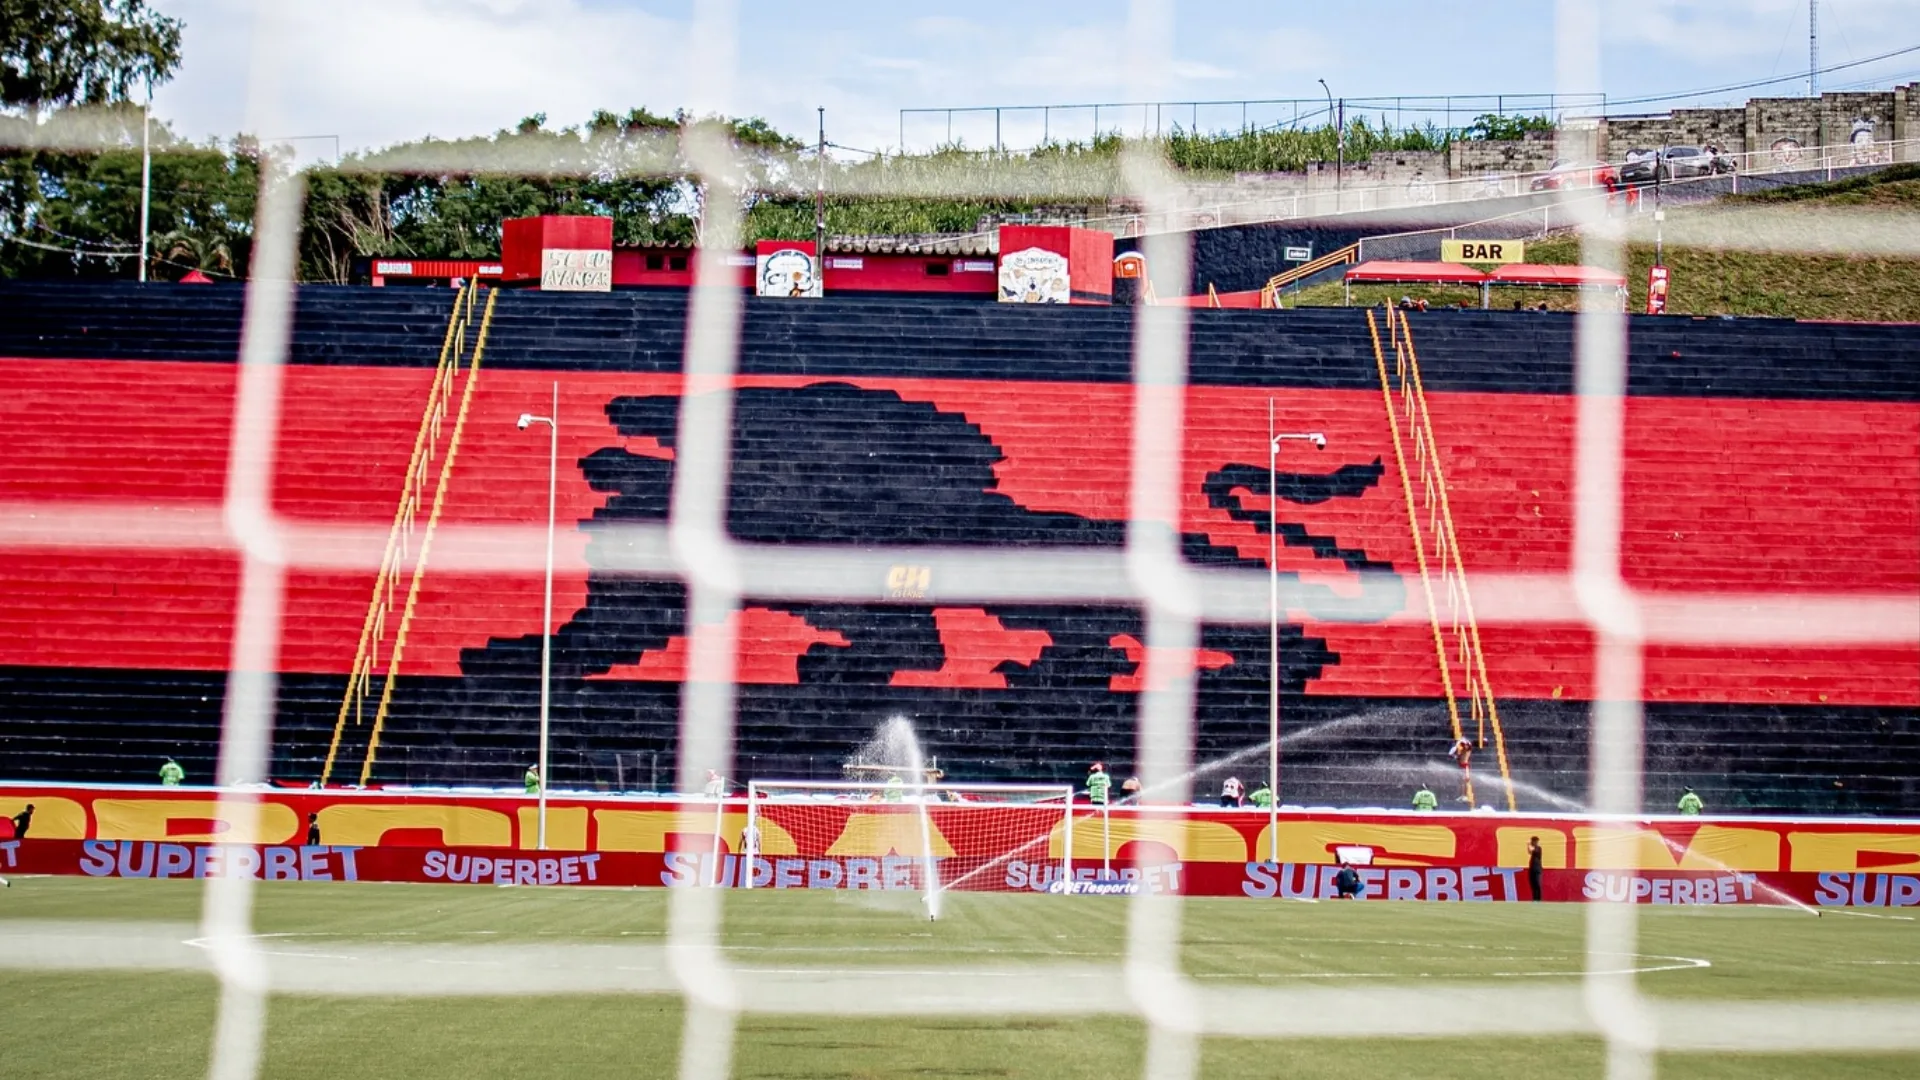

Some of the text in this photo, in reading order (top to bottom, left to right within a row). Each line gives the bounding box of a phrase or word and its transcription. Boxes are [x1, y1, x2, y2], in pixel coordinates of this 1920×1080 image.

[1462, 243, 1502, 259] BAR
[80, 839, 363, 881] SUPERBET
[423, 851, 600, 885] SUPERBET
[1582, 870, 1756, 905] SUPERBET
